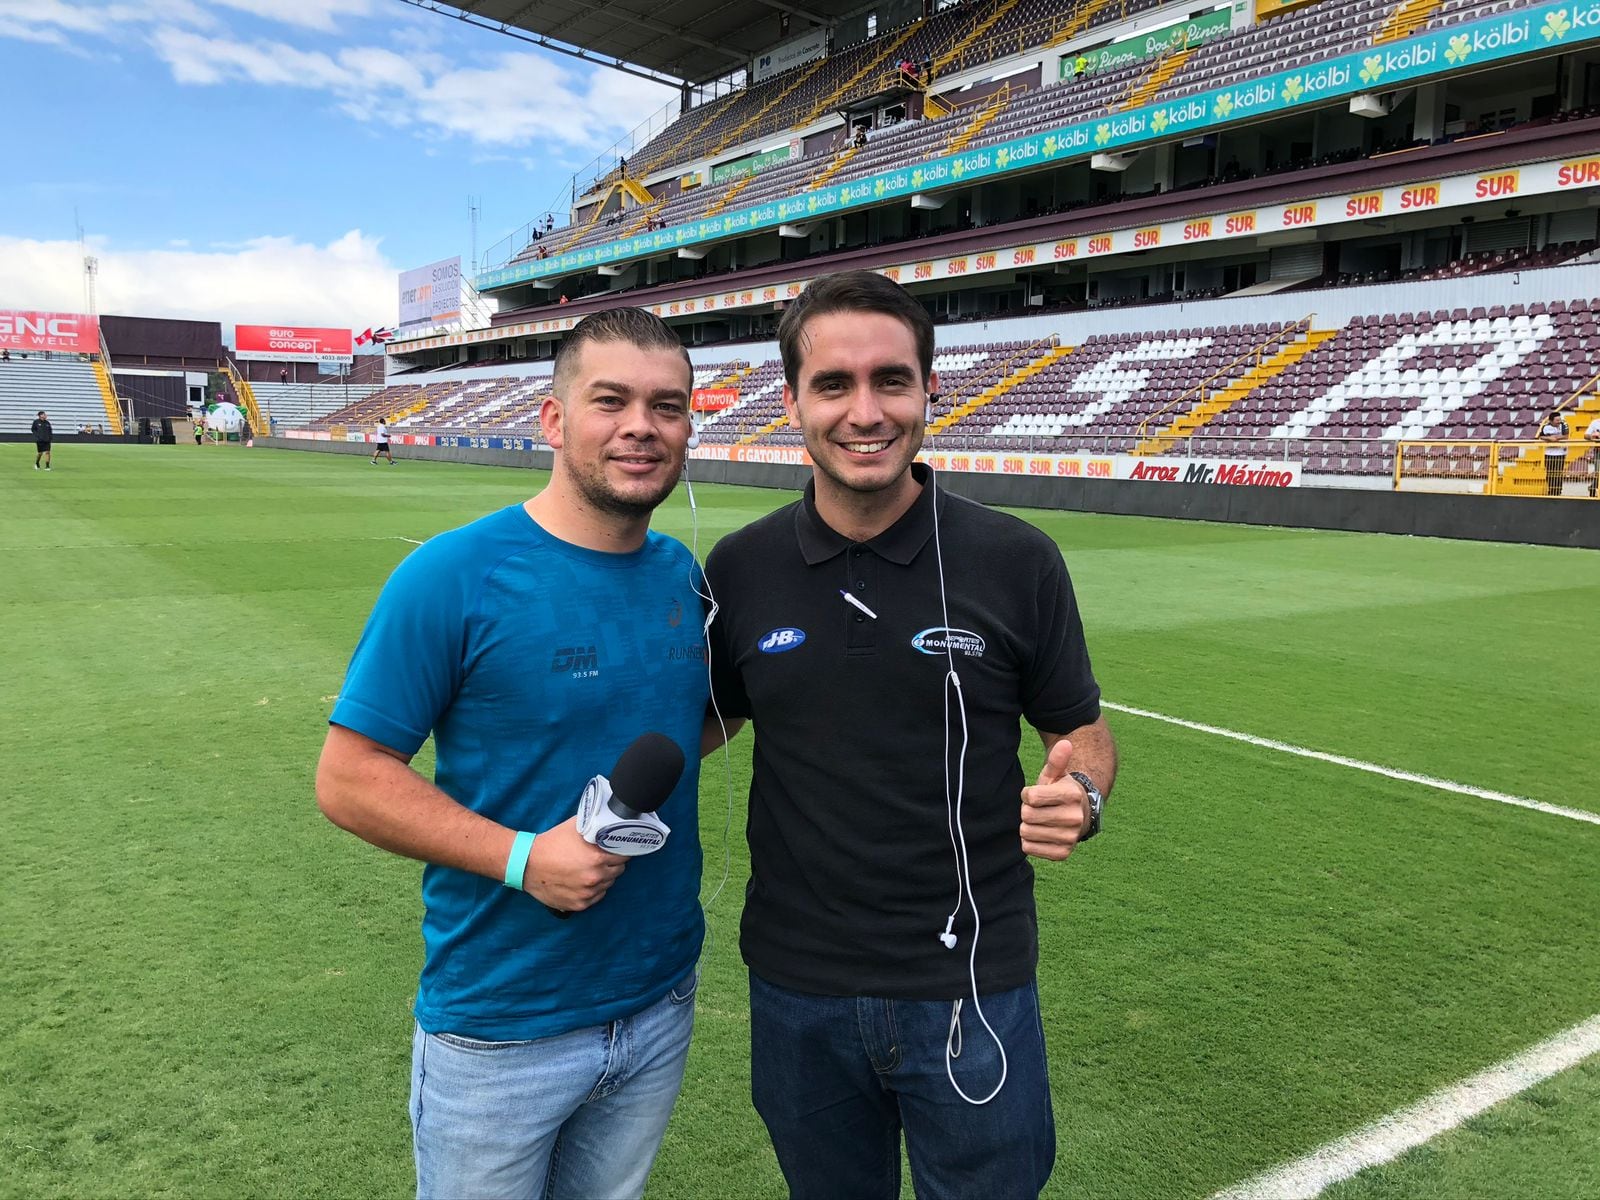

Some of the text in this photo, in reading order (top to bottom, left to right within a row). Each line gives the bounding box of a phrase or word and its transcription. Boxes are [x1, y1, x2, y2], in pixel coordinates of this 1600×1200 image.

[1146, 22, 1229, 53] Dos Pinos
[1100, 51, 1136, 67] Pinos
[817, 192, 837, 207] kölbi
[850, 183, 871, 199] kölbi
[885, 174, 908, 191] kölbi
[923, 163, 948, 181] kölbi
[965, 153, 991, 172] kölbi
[1009, 142, 1038, 161] kölbi
[1058, 129, 1089, 150] kölbi
[1111, 115, 1146, 138] kölbi
[1169, 100, 1206, 124] kölbi
[1234, 83, 1276, 109] kölbi
[1304, 64, 1350, 93] kölbi
[1386, 42, 1437, 73] kölbi
[1473, 20, 1530, 52] kölbi
[763, 289, 776, 301] SUR
[786, 285, 800, 298] SUR
[914, 264, 932, 279] SUR
[948, 259, 967, 274] SUR
[976, 255, 995, 270] SUR
[1014, 249, 1034, 265] SUR
[1054, 243, 1076, 259] SUR
[1088, 237, 1111, 254] SUR
[1134, 230, 1158, 248] SUR
[1184, 221, 1210, 240] SUR
[1226, 215, 1254, 234] SUR
[1283, 206, 1314, 226] SUR
[1346, 196, 1380, 217] SUR
[1400, 187, 1437, 209] SUR
[1476, 175, 1515, 199] SUR
[1558, 161, 1600, 186] SUR
[432, 263, 459, 282] SOMOS
[31, 336, 79, 346] WELL
[269, 329, 294, 338] euro
[706, 394, 735, 406] TOYOTA
[746, 448, 804, 465] GATORADE
[951, 458, 969, 471] SUR
[975, 458, 994, 472] SUR
[1003, 459, 1023, 473] SUR
[1029, 460, 1050, 474] SUR
[1057, 461, 1080, 476] SUR
[1087, 462, 1110, 477] SUR
[1129, 461, 1180, 481] Arroz
[1212, 463, 1293, 488] Máximo
[925, 639, 984, 652] MONUMENTAL
[572, 671, 588, 679] 93.5
[607, 835, 661, 846] MONUMENTAL
